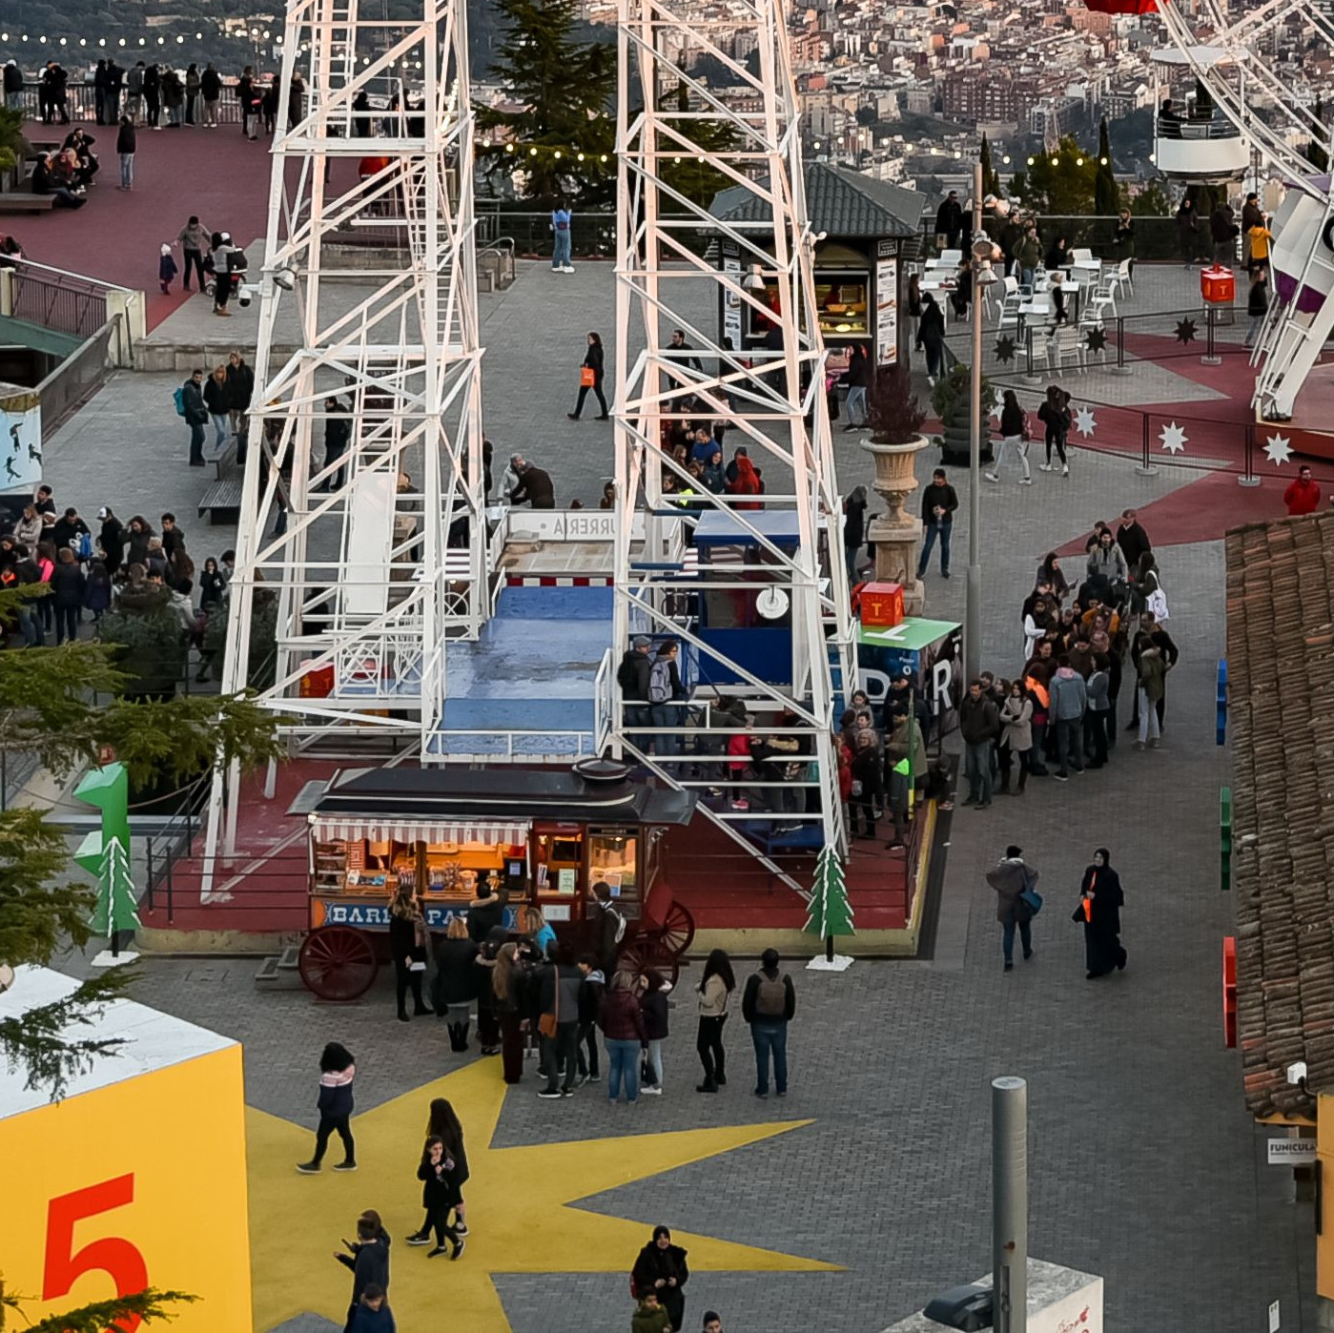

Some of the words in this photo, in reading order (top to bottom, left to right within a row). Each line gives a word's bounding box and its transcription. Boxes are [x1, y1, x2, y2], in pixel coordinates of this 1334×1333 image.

[871, 603, 883, 617] T
[1270, 1143, 1316, 1152] FUNICULA
[42, 1172, 149, 1333] 5
